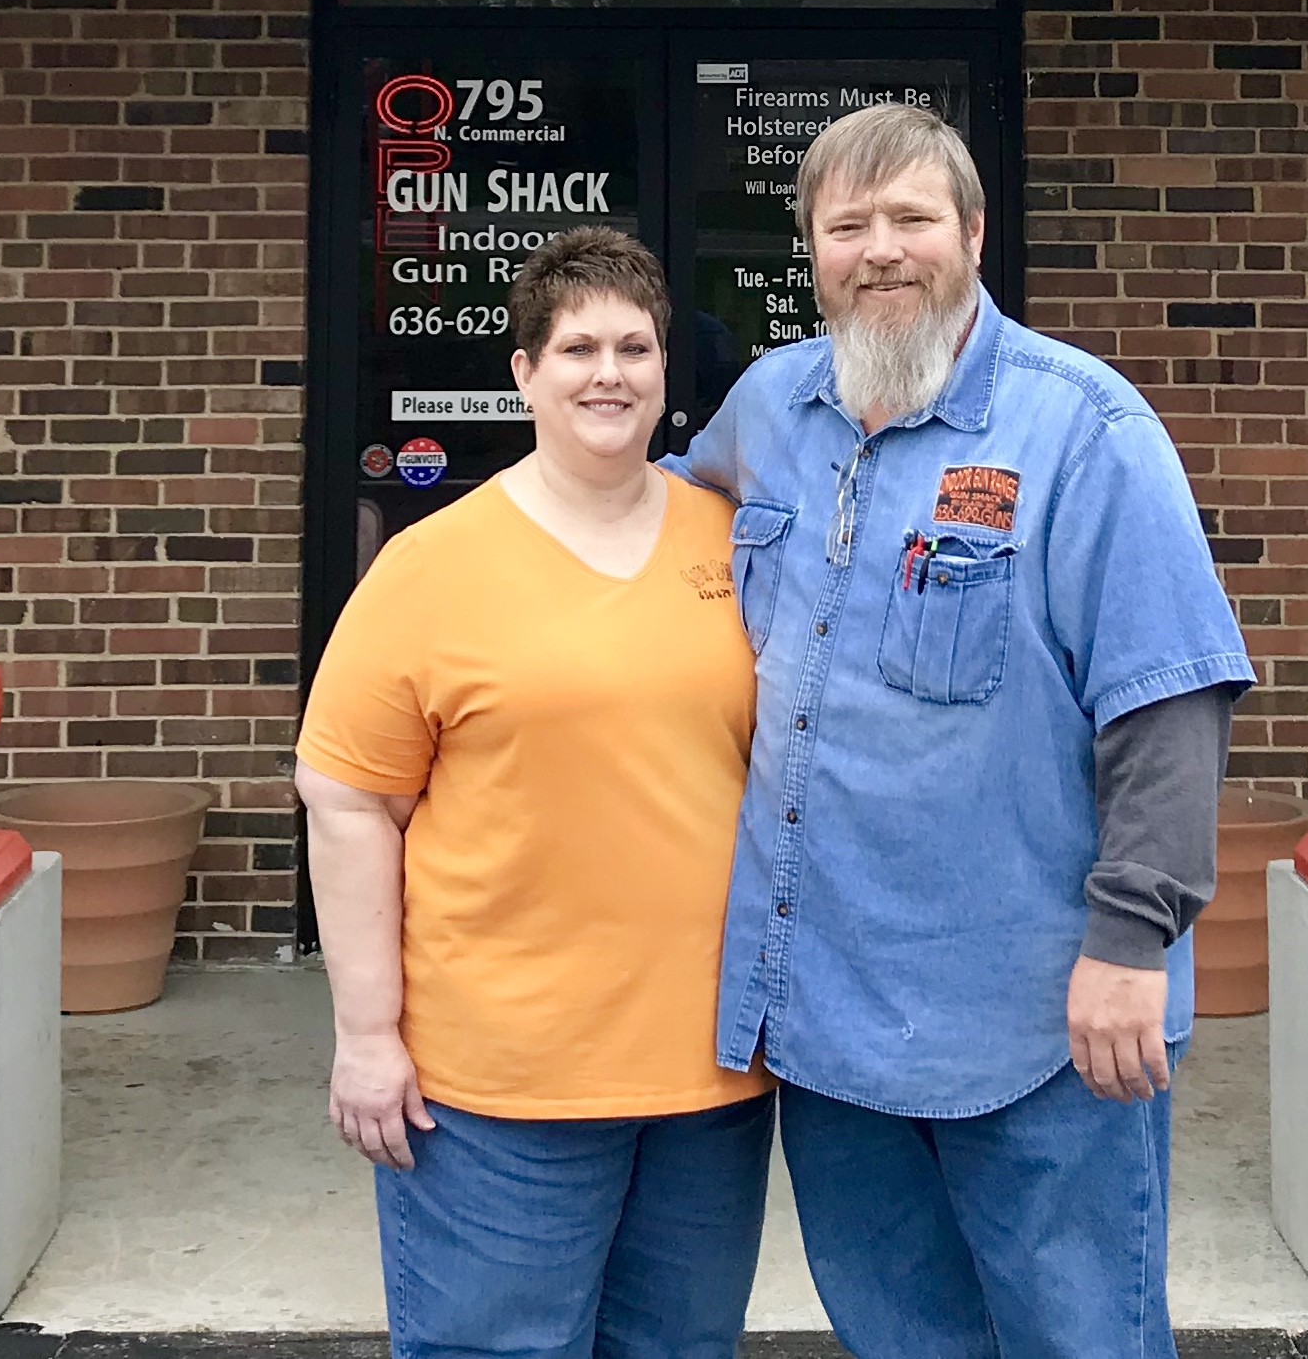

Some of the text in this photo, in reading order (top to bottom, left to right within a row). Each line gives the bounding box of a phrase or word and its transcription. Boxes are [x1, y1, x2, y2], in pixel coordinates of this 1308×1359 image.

[456, 79, 544, 121] 795
[736, 87, 931, 108] Firearms Must Be
[434, 125, 565, 142] N. Commercial
[727, 116, 831, 136] Holstered
[386, 169, 610, 213] GUN SHACK
[745, 181, 765, 194] Will
[438, 224, 560, 251] Indoor
[392, 257, 467, 283] Gun
[734, 268, 769, 288] Tue.
[787, 268, 812, 288] Fri.
[766, 293, 799, 314] Sat.
[769, 319, 807, 340] Sun.
[402, 397, 453, 414] Please
[461, 397, 489, 414] Use
